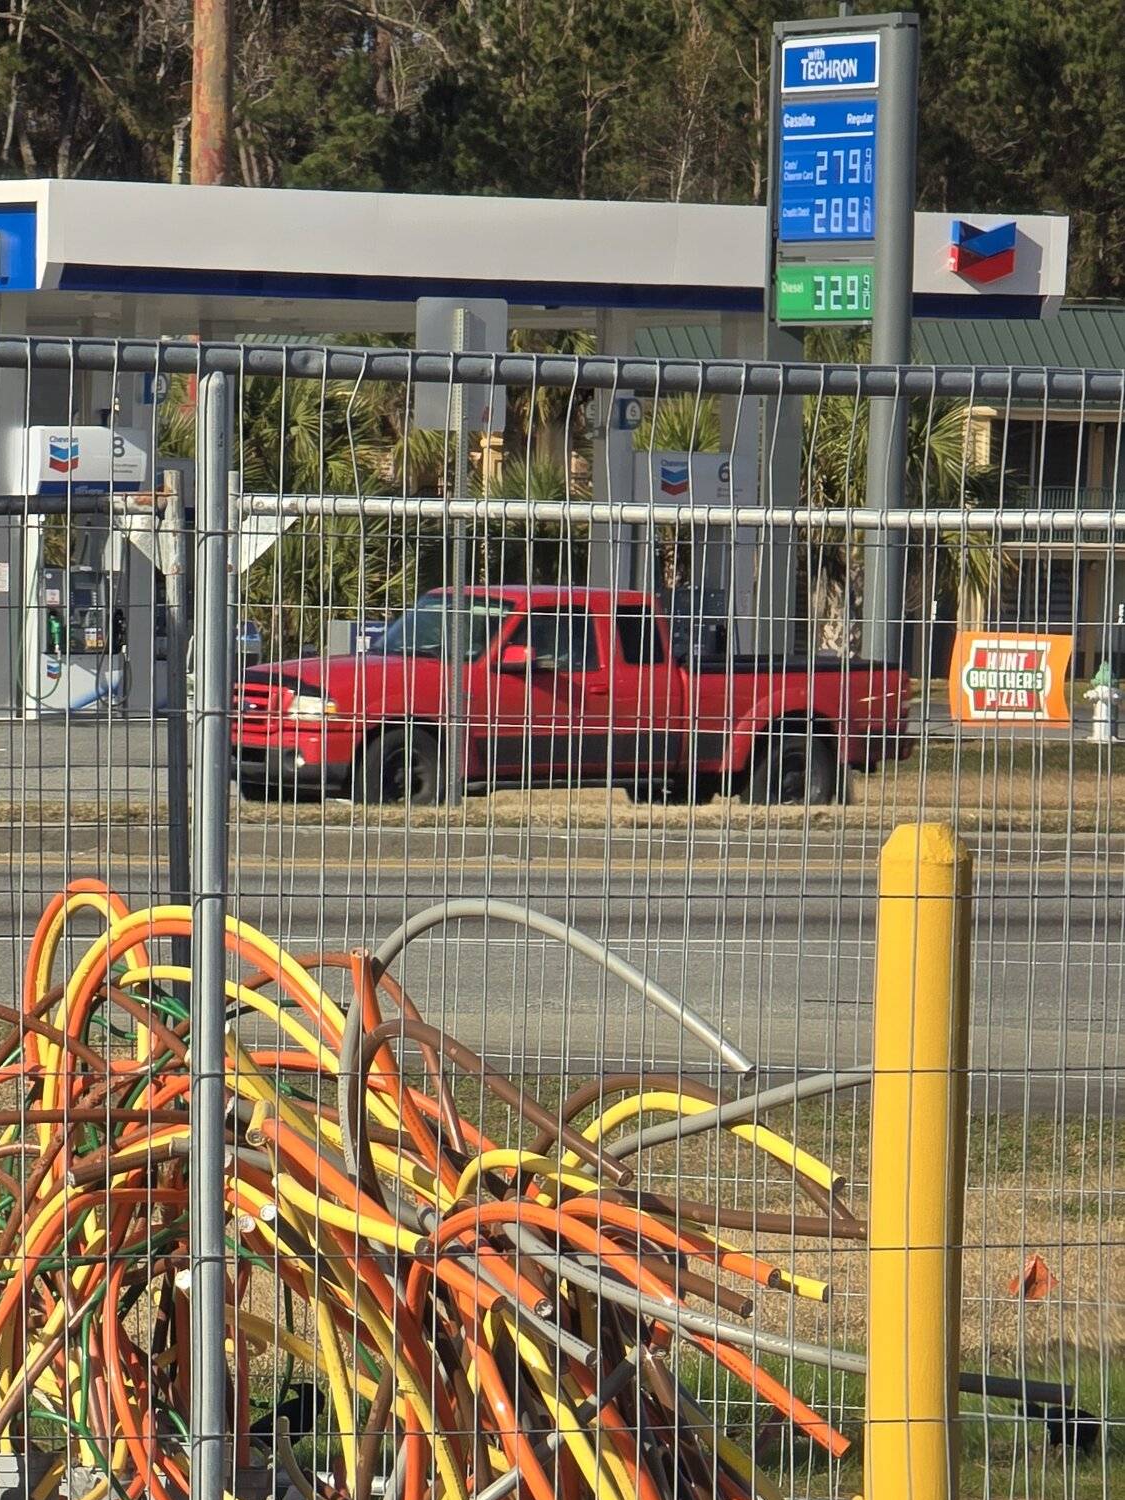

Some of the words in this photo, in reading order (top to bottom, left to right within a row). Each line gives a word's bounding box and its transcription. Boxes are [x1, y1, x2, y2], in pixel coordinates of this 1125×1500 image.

[800, 58, 859, 83] TECHRON
[783, 113, 816, 128] Gasoline
[846, 113, 874, 126] Regular
[781, 281, 804, 294] Diesel
[986, 651, 1029, 671] HUNT
[969, 670, 1044, 689] BROTHERS
[986, 689, 1028, 707] PIZZA
